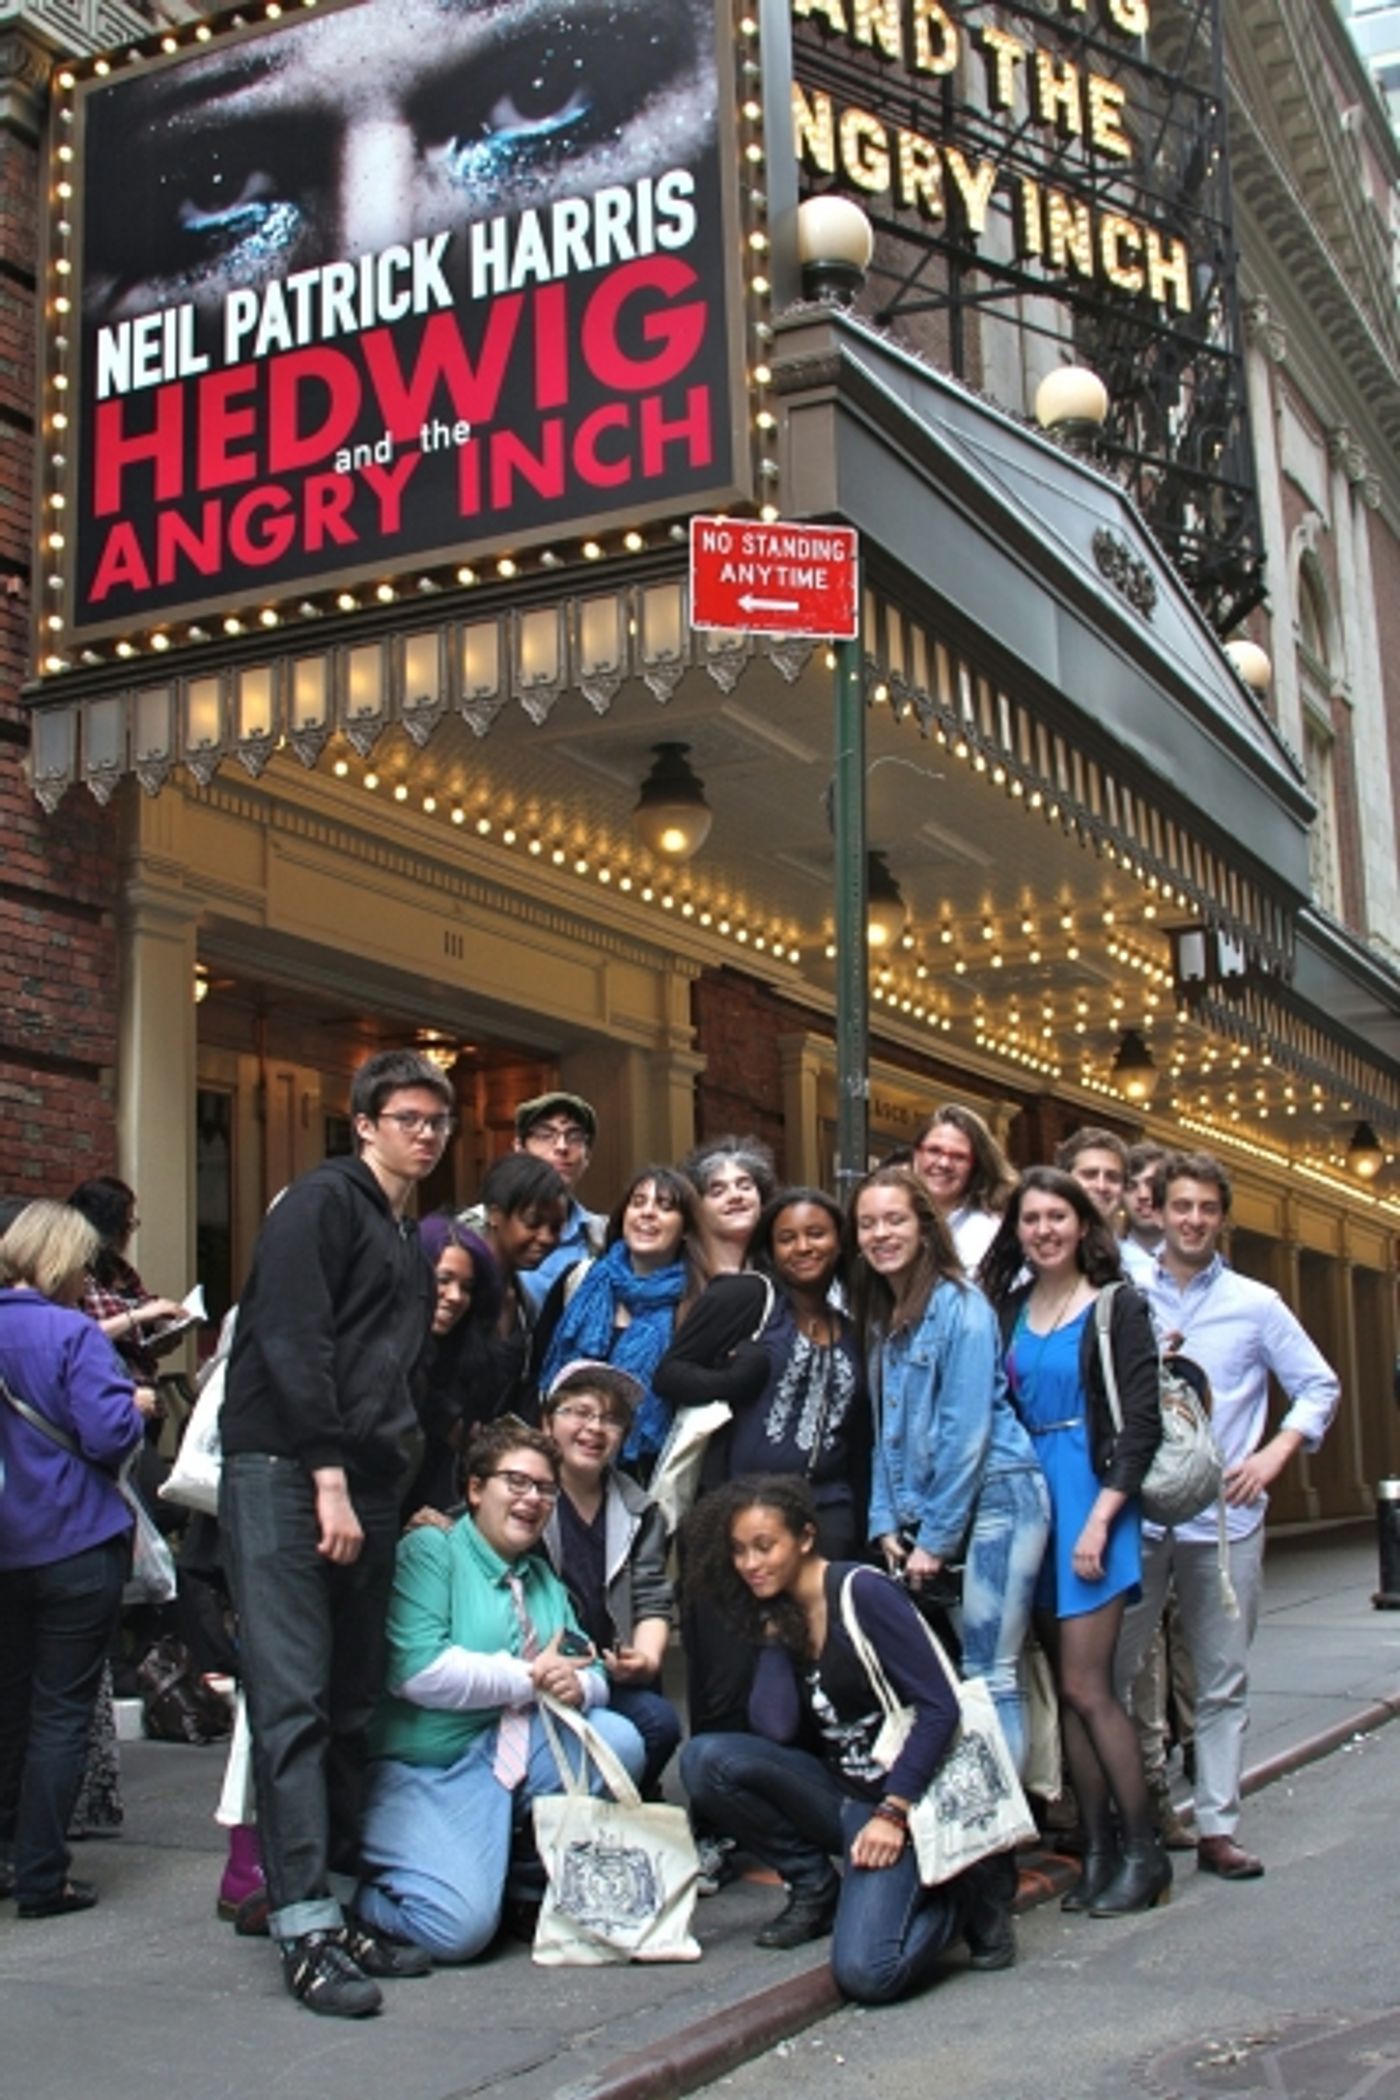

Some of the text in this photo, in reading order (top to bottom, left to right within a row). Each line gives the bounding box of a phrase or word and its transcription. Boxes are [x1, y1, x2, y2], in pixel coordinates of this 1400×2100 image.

[982, 24, 1134, 159] THE
[96, 168, 697, 399] NEIL PATRICK HARRIS
[792, 81, 1192, 314] NGRY INCH
[93, 255, 708, 518] HEDWIG
[333, 417, 471, 475] and the
[87, 384, 713, 603] ANGRY INCH
[702, 529, 846, 562] NO STANDING
[719, 562, 829, 590] ANYTIME
